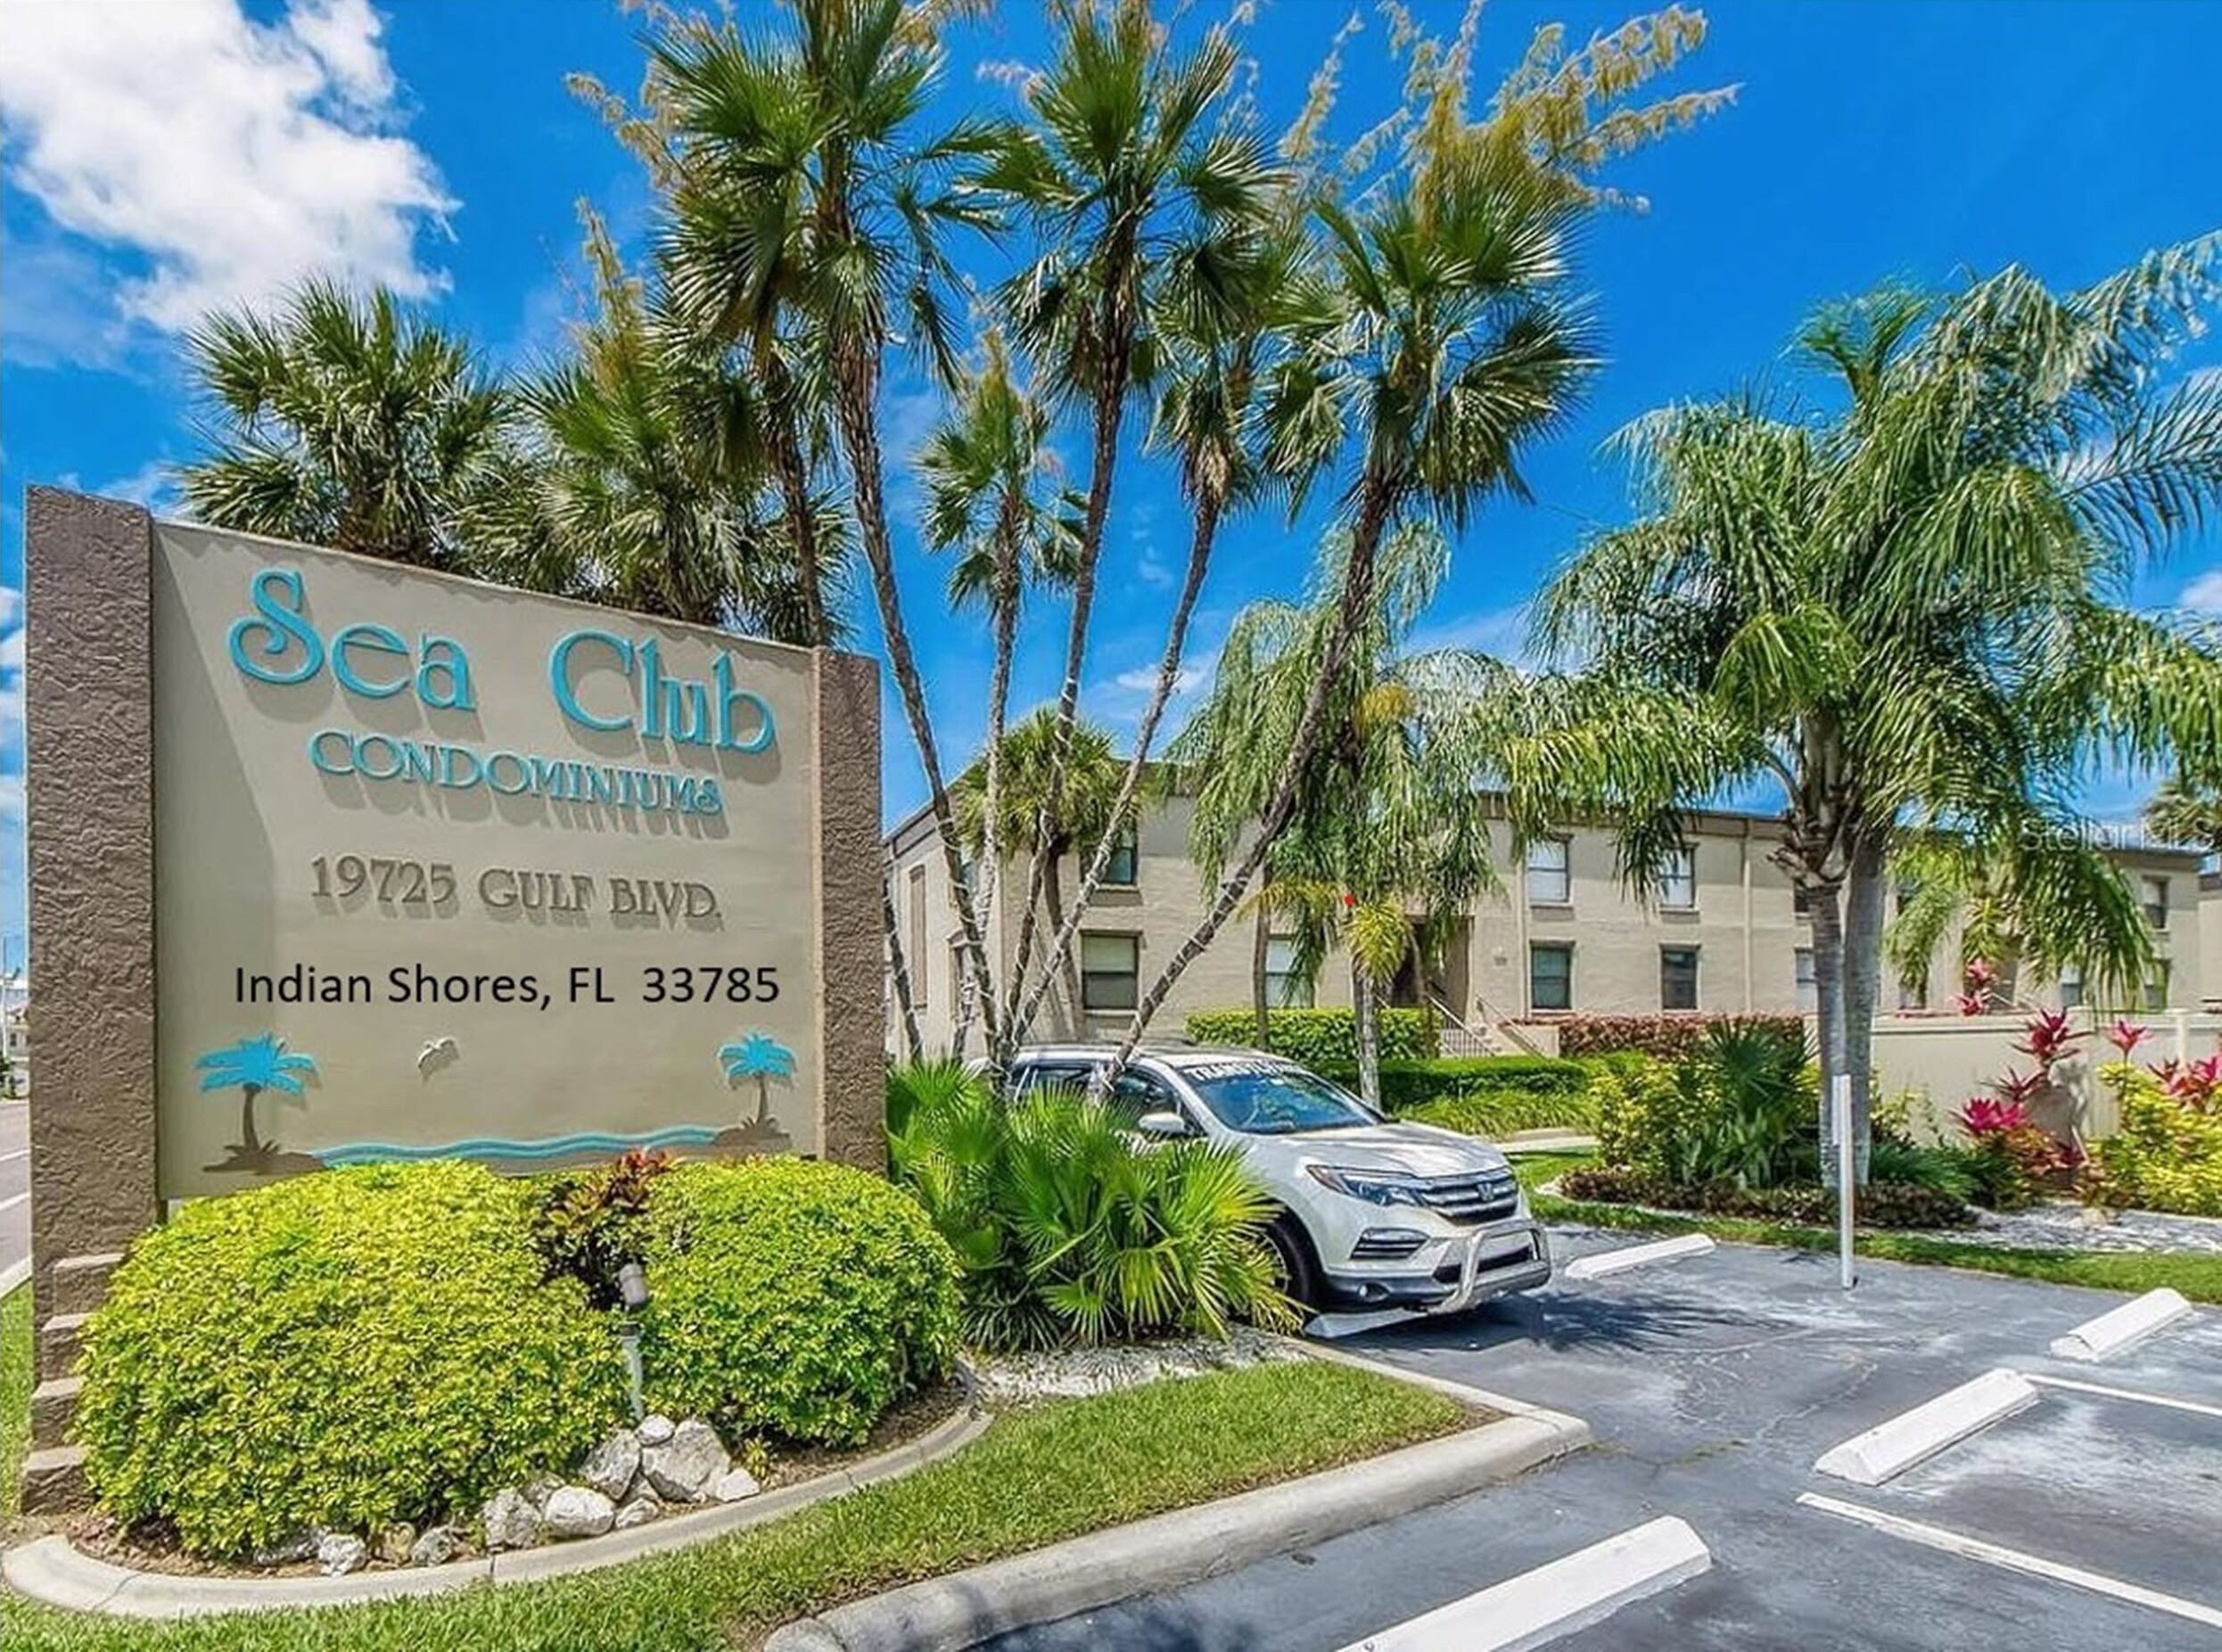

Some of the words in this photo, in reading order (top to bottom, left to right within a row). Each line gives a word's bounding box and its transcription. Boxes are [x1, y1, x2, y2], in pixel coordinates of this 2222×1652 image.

[229, 568, 477, 711] Sea
[548, 628, 775, 753] Club
[309, 730, 723, 815] CONDOMINIUMS
[310, 854, 457, 905] 19725
[478, 868, 595, 910] GULF
[609, 875, 723, 920] BLVD.
